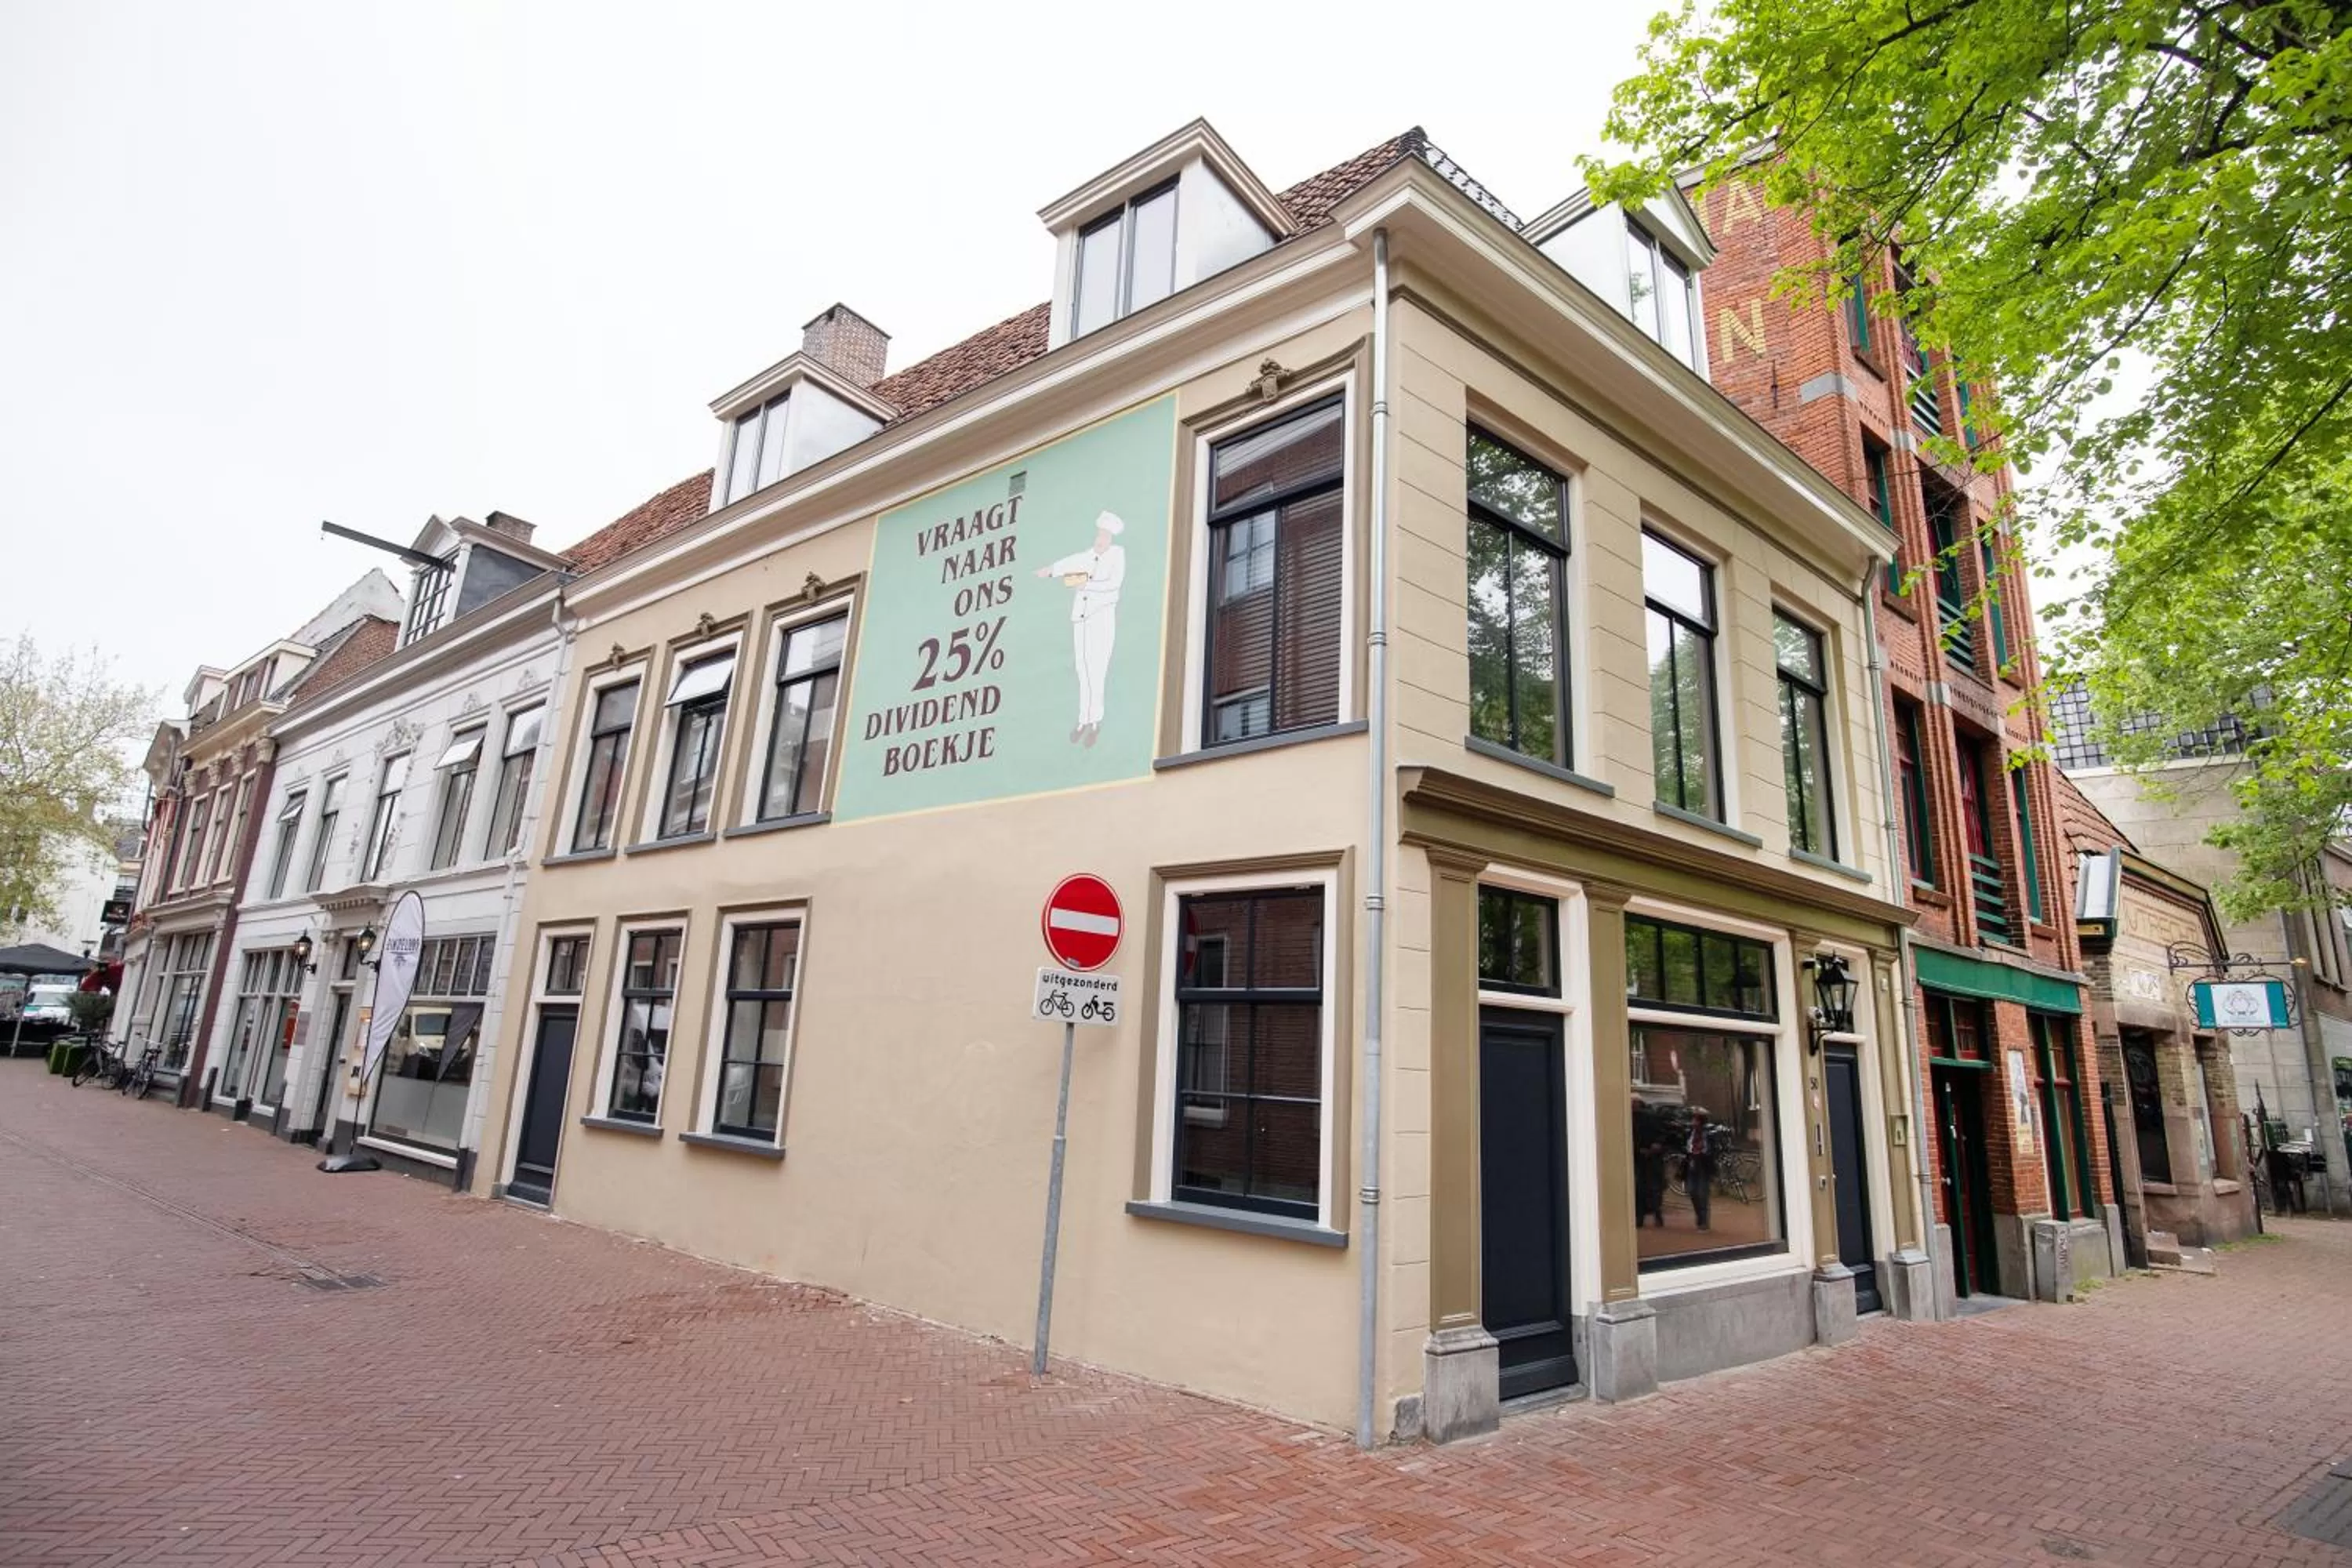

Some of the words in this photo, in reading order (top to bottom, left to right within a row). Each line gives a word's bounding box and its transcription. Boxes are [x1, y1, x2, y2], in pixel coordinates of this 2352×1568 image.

[916, 495, 1023, 556] VRAAGT
[941, 535, 1018, 584] NAAR
[953, 575, 1014, 617] ONS
[911, 615, 1007, 691] 25%
[864, 684, 1002, 742] DIVIDEND
[883, 727, 996, 777] BOEKJE
[1042, 973, 1118, 992] uitgezonderd
